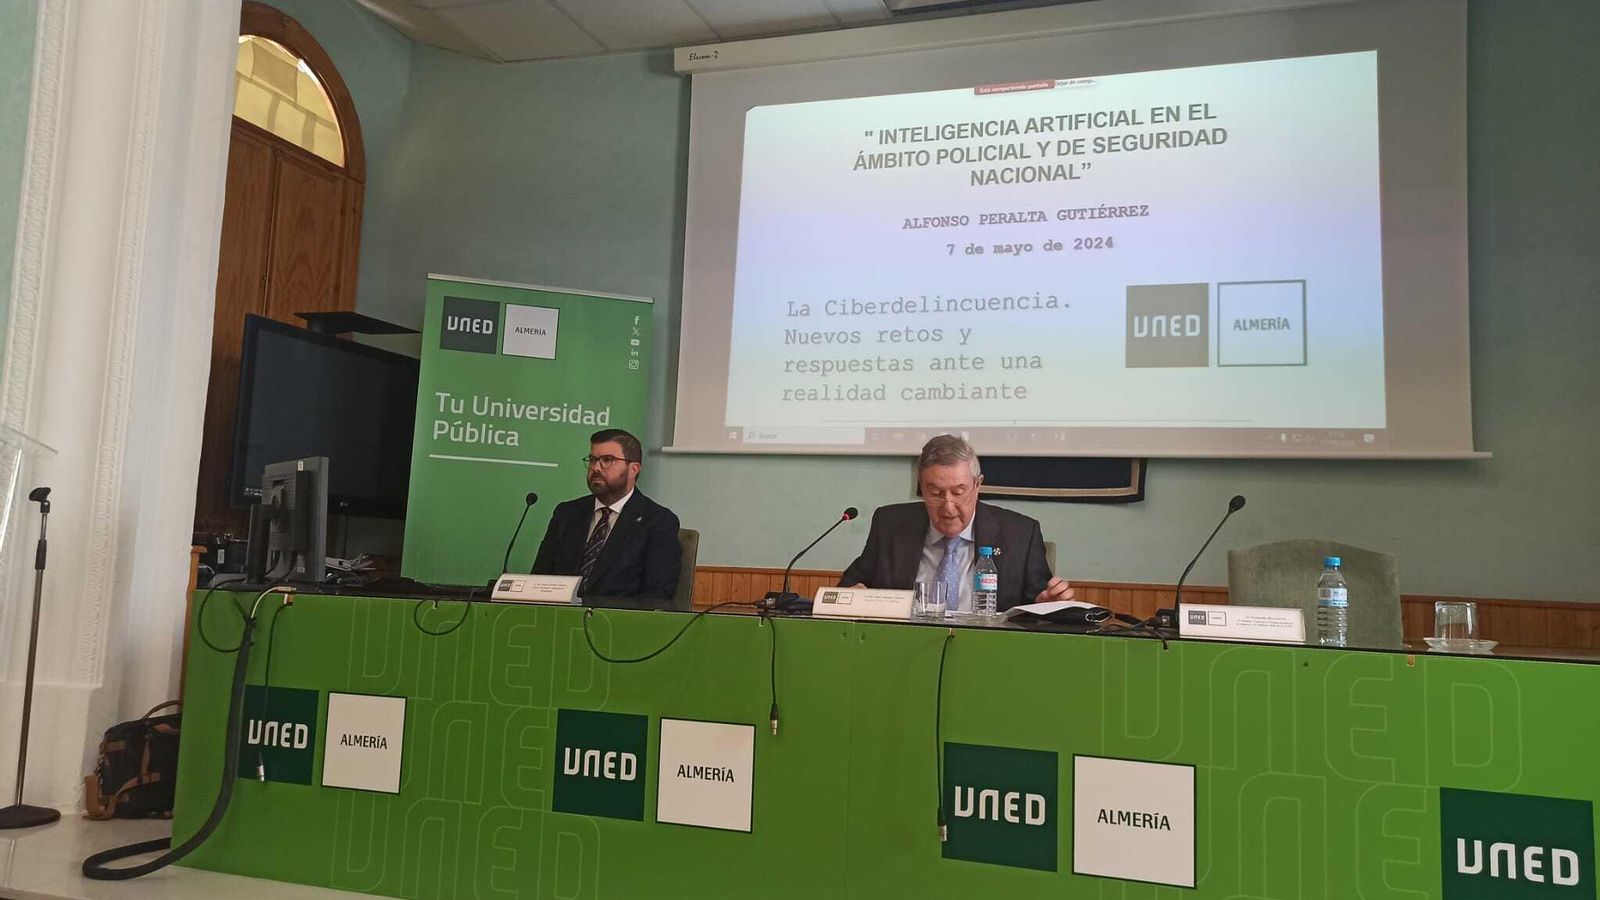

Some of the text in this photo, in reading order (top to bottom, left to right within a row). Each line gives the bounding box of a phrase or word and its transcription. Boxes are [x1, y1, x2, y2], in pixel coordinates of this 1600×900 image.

[878, 118, 1020, 145] INTELIGENCIA
[1024, 108, 1144, 134] ARTIFICIAL
[1150, 106, 1181, 124] EN
[1188, 102, 1218, 121] EL
[853, 127, 1229, 172] ÁMBITO POLICIAL Y DE SEGURIDAD
[902, 204, 1150, 230] ALFONSO PERALTA GUTIÉRREZ
[946, 236, 1114, 257] 7 de mayo de 2024
[786, 291, 1072, 318] La Ciberdelincuencia.
[446, 315, 494, 335] UNED
[514, 326, 547, 336] ALMERÍA
[784, 326, 972, 346] Nuevos retos y
[1133, 314, 1201, 338] UNED
[1232, 316, 1291, 332] ALMERÍA
[783, 354, 1043, 376] respuestas ante una
[782, 383, 1028, 402] realidad cambiante
[435, 392, 611, 427] Tu Universidad
[432, 420, 520, 447] Pública
[248, 719, 309, 750] UNED
[340, 733, 388, 750] ALMERÍA
[563, 747, 637, 782] UNED
[676, 764, 735, 783] ALMERÍA
[954, 786, 1046, 826] UNED
[1096, 808, 1172, 832] ALMERÍA
[1456, 838, 1580, 886] UNED
